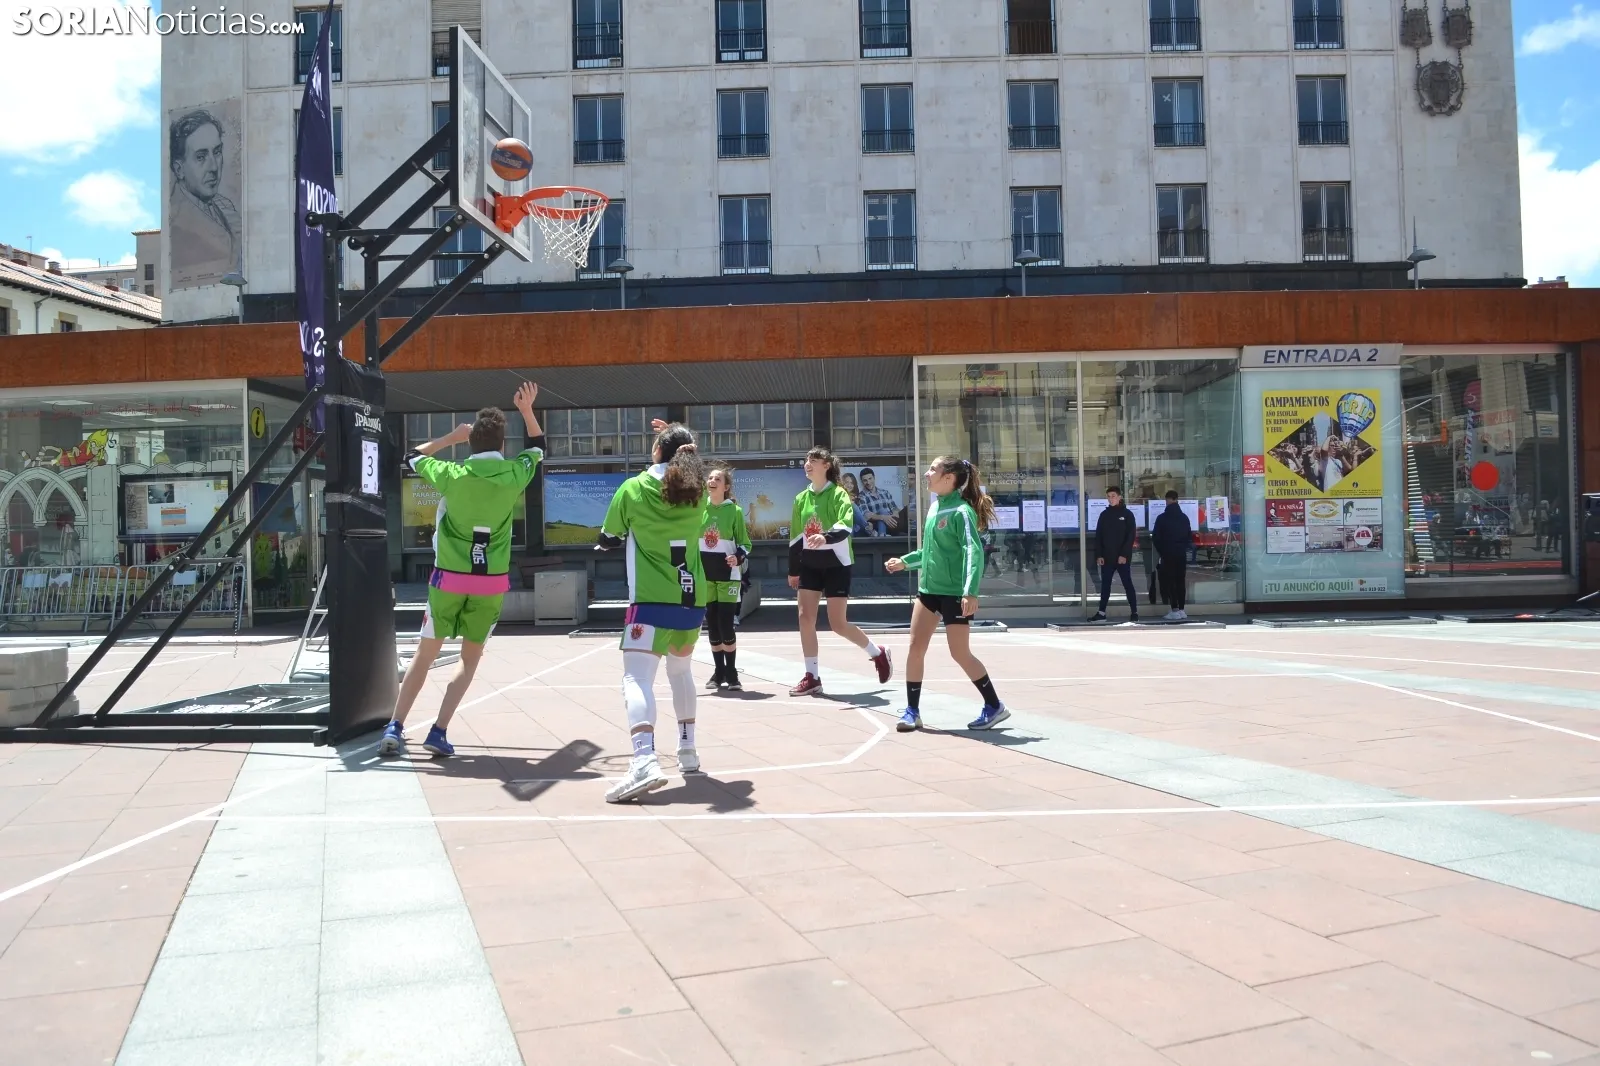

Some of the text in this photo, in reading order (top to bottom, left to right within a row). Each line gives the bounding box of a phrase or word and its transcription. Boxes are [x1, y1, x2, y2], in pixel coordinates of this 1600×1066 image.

[1263, 348, 1379, 364] ENTRADA 2
[1264, 395, 1330, 408] CAMPAMENTOS
[1339, 398, 1374, 421] TRIP
[366, 455, 374, 477] 3
[1267, 479, 1289, 487] CURSOS
[1276, 487, 1312, 496] EXTRANJERO
[1298, 501, 1304, 510] 2
[728, 586, 738, 596] 26
[1264, 579, 1354, 594] ¡TU ANUNCIO AQUÍ!
